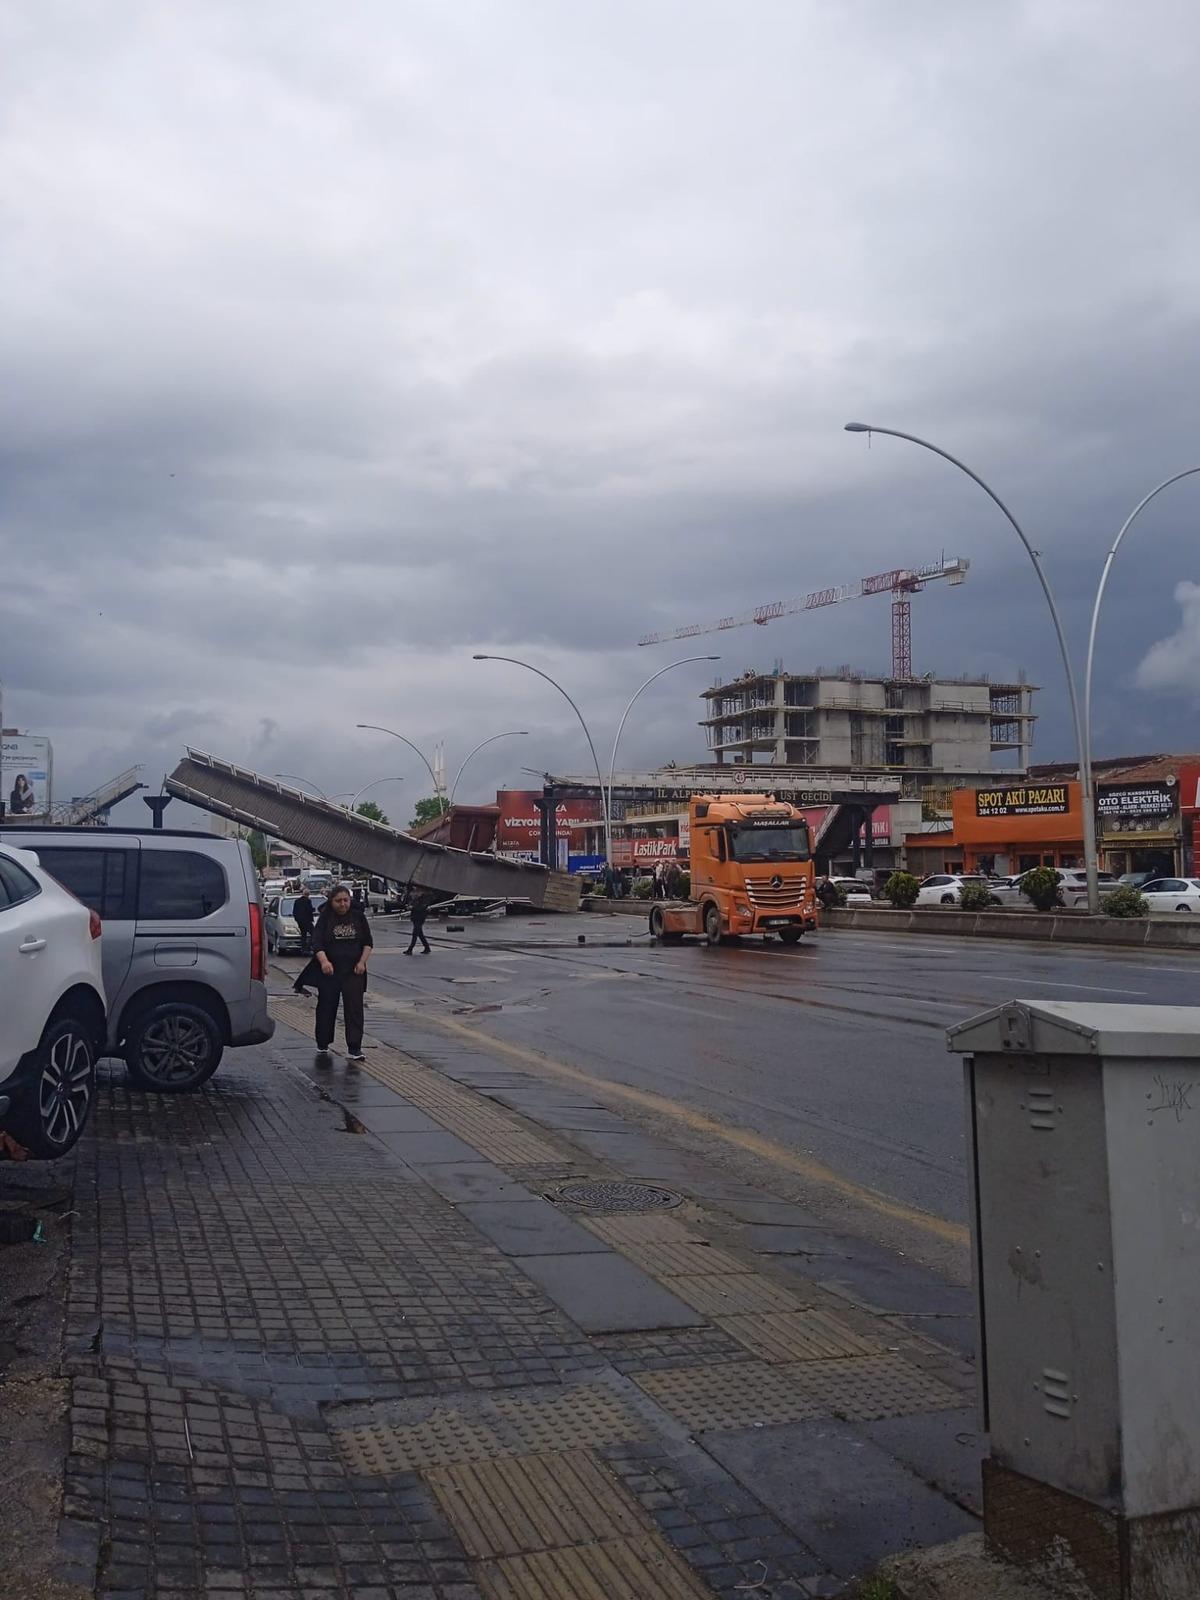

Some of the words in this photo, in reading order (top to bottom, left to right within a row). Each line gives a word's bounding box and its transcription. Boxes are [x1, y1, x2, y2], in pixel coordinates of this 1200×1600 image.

[978, 792, 1003, 807] SPOT
[1005, 788, 1025, 806] AKÜ
[1028, 788, 1065, 804] PAZARI
[1098, 797, 1119, 806] OTO
[1120, 793, 1171, 805] ELEKTRİK
[991, 807, 999, 815] 12
[999, 807, 1007, 815] 02
[633, 840, 677, 856] LastikPark
